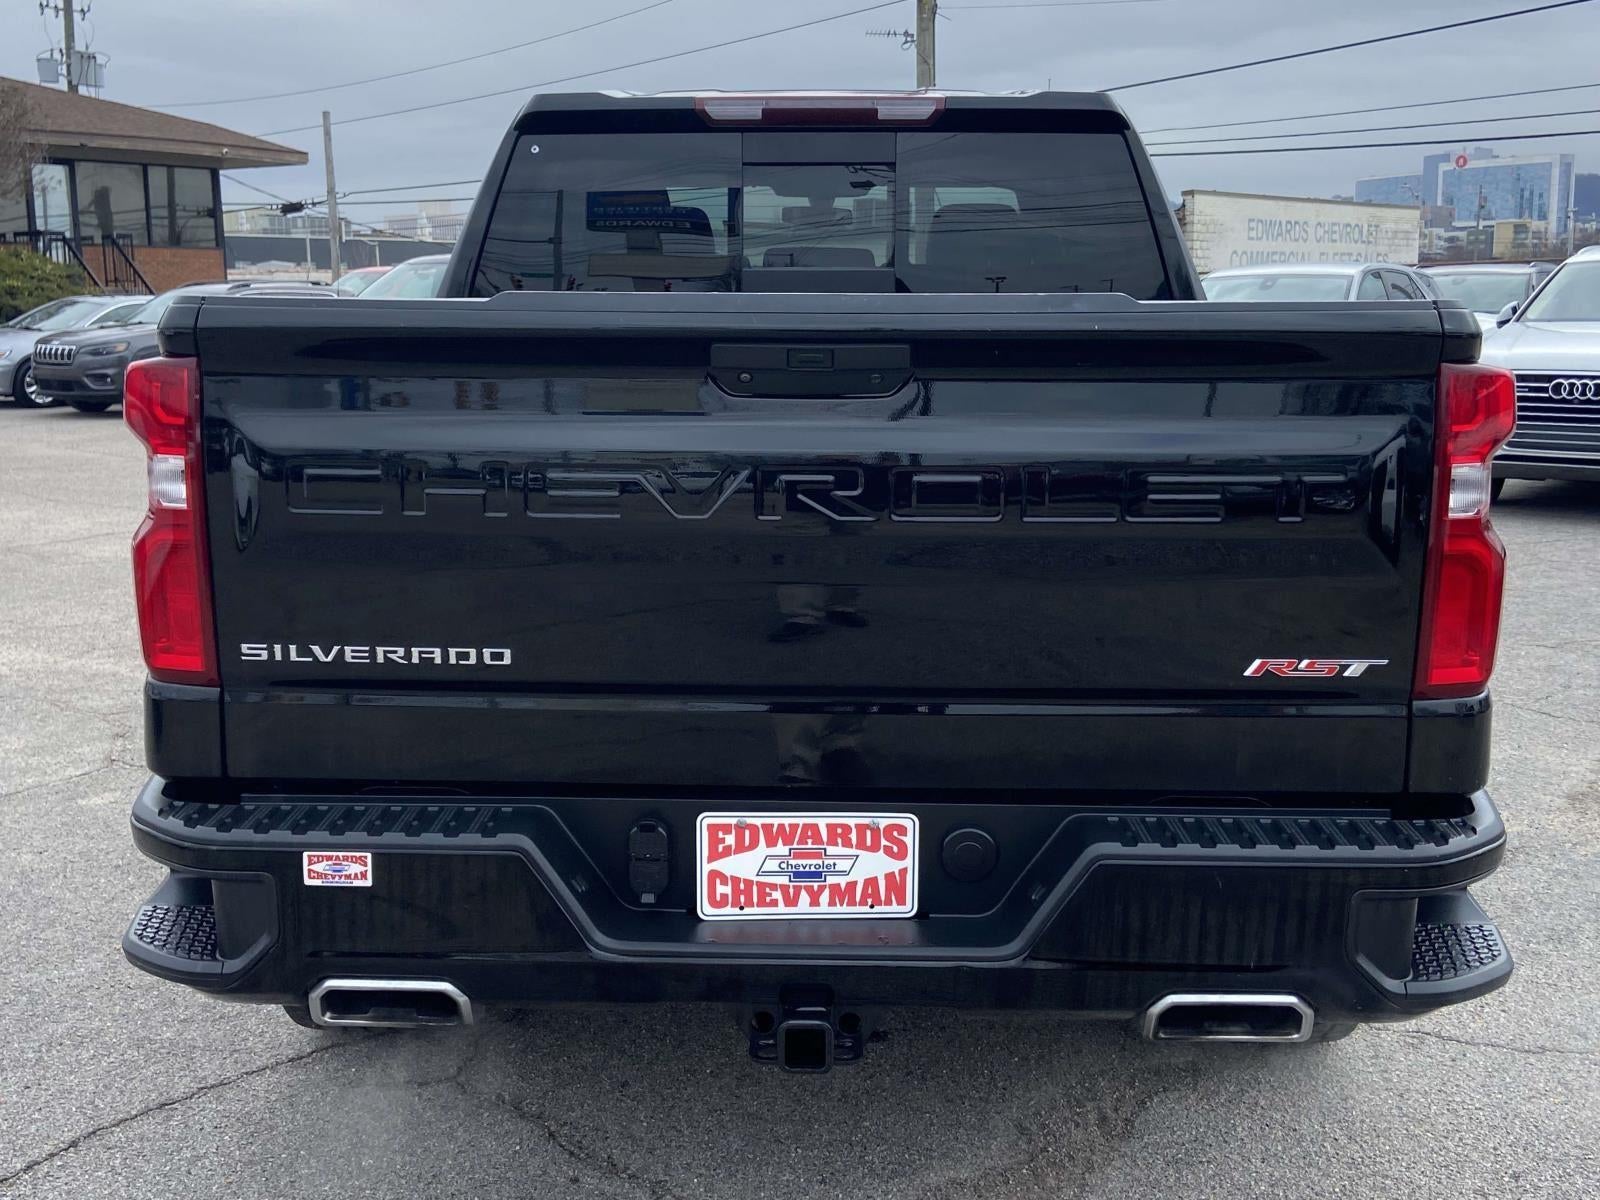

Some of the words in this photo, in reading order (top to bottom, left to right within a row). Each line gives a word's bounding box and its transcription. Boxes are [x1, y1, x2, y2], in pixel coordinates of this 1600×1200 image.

[1247, 218, 1309, 243] EDWARDS
[1314, 221, 1380, 246] CHEVROLET
[285, 459, 1348, 525] CHEVROLET
[240, 643, 512, 665] SILVERADO
[1243, 658, 1389, 677] RST
[706, 822, 909, 865] EDWARDS
[307, 854, 368, 867] EDWARDS
[778, 860, 837, 871] Chevrolet
[706, 867, 909, 909] CHEVYMAN
